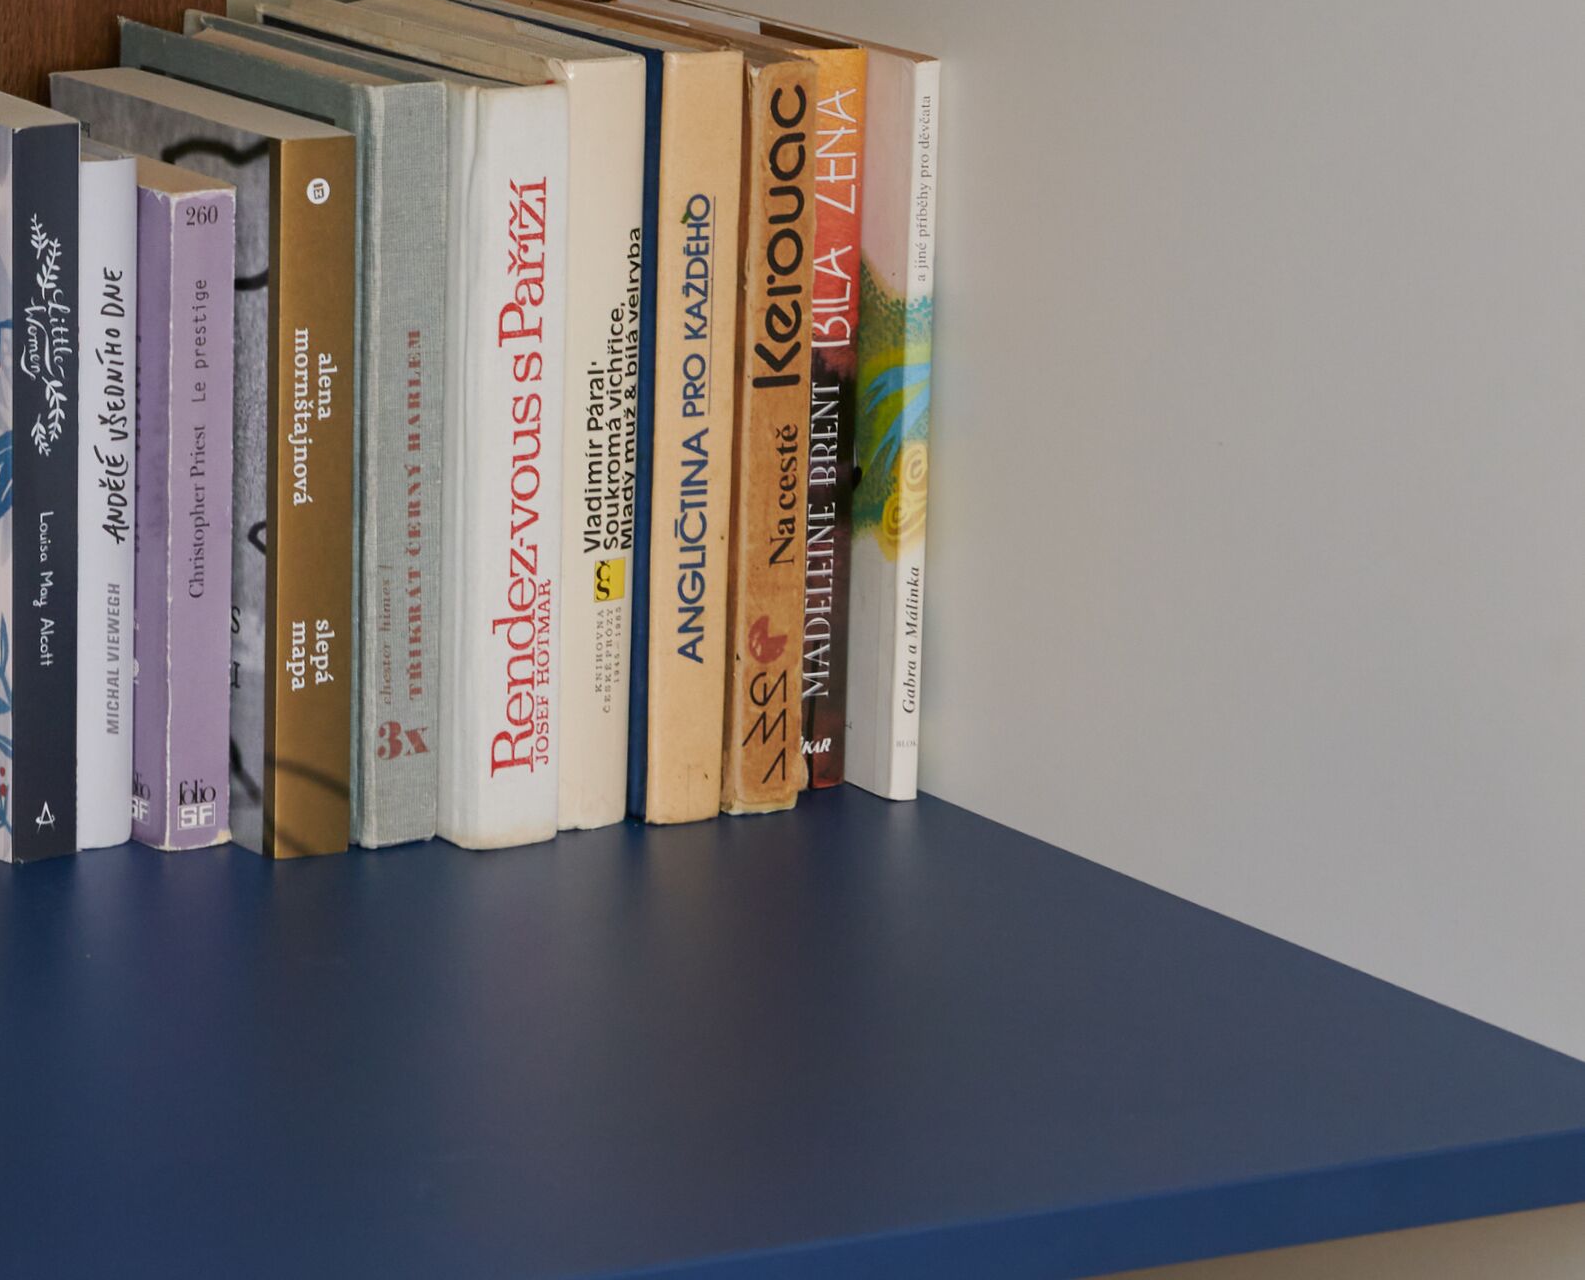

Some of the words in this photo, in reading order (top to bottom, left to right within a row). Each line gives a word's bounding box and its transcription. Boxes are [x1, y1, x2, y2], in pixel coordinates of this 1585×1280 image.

[917, 94, 931, 150] děvčata
[920, 152, 932, 178] pro
[185, 204, 218, 226] 260
[751, 84, 807, 389] Kerouac
[916, 182, 932, 238] příběhy
[498, 176, 547, 348] Paříží
[627, 226, 642, 324] velryba
[914, 241, 930, 270] jiné
[917, 274, 926, 283] a
[100, 266, 125, 318] DNE
[191, 278, 210, 370] prestige
[20, 297, 48, 381] Women
[46, 289, 73, 380] Little
[512, 350, 543, 383] s
[607, 301, 625, 411] vichřice,
[625, 329, 639, 378] bílá
[191, 381, 207, 404] Le
[288, 327, 314, 507] mornštajnová
[317, 351, 339, 421] alena
[407, 329, 422, 452] HARLEM
[624, 383, 636, 400] &
[682, 352, 706, 418] PRO
[189, 423, 206, 479] Priest
[624, 404, 637, 464] muž
[775, 423, 799, 511] cestě
[808, 381, 841, 488] BRENT
[403, 463, 422, 558] ČERNÝ
[583, 438, 603, 554] Vladimír
[604, 417, 622, 551] Soukromá
[620, 471, 636, 550] Mladý
[39, 510, 55, 563] Louisa
[189, 483, 210, 599] Christopher
[769, 517, 797, 568] Na
[32, 570, 55, 608] May
[378, 578, 392, 633] himes
[491, 392, 542, 778] Rendez-vous
[801, 501, 837, 700] MADELEINE
[904, 565, 920, 638] Málinka
[39, 617, 55, 668] Alcott
[106, 583, 121, 662] VIEWEGH
[286, 620, 307, 692] mapa
[310, 618, 335, 686] slepá
[535, 578, 551, 685] HOTMAR
[595, 609, 605, 693] KNIHOVNA
[908, 643, 918, 655] a
[106, 666, 120, 736] MICHAL
[378, 643, 392, 705] chester
[902, 660, 918, 715] Gabra
[376, 720, 431, 761] 3x
[535, 694, 550, 766] JOSEF
[178, 779, 216, 806] folio
[179, 803, 214, 828] SF
